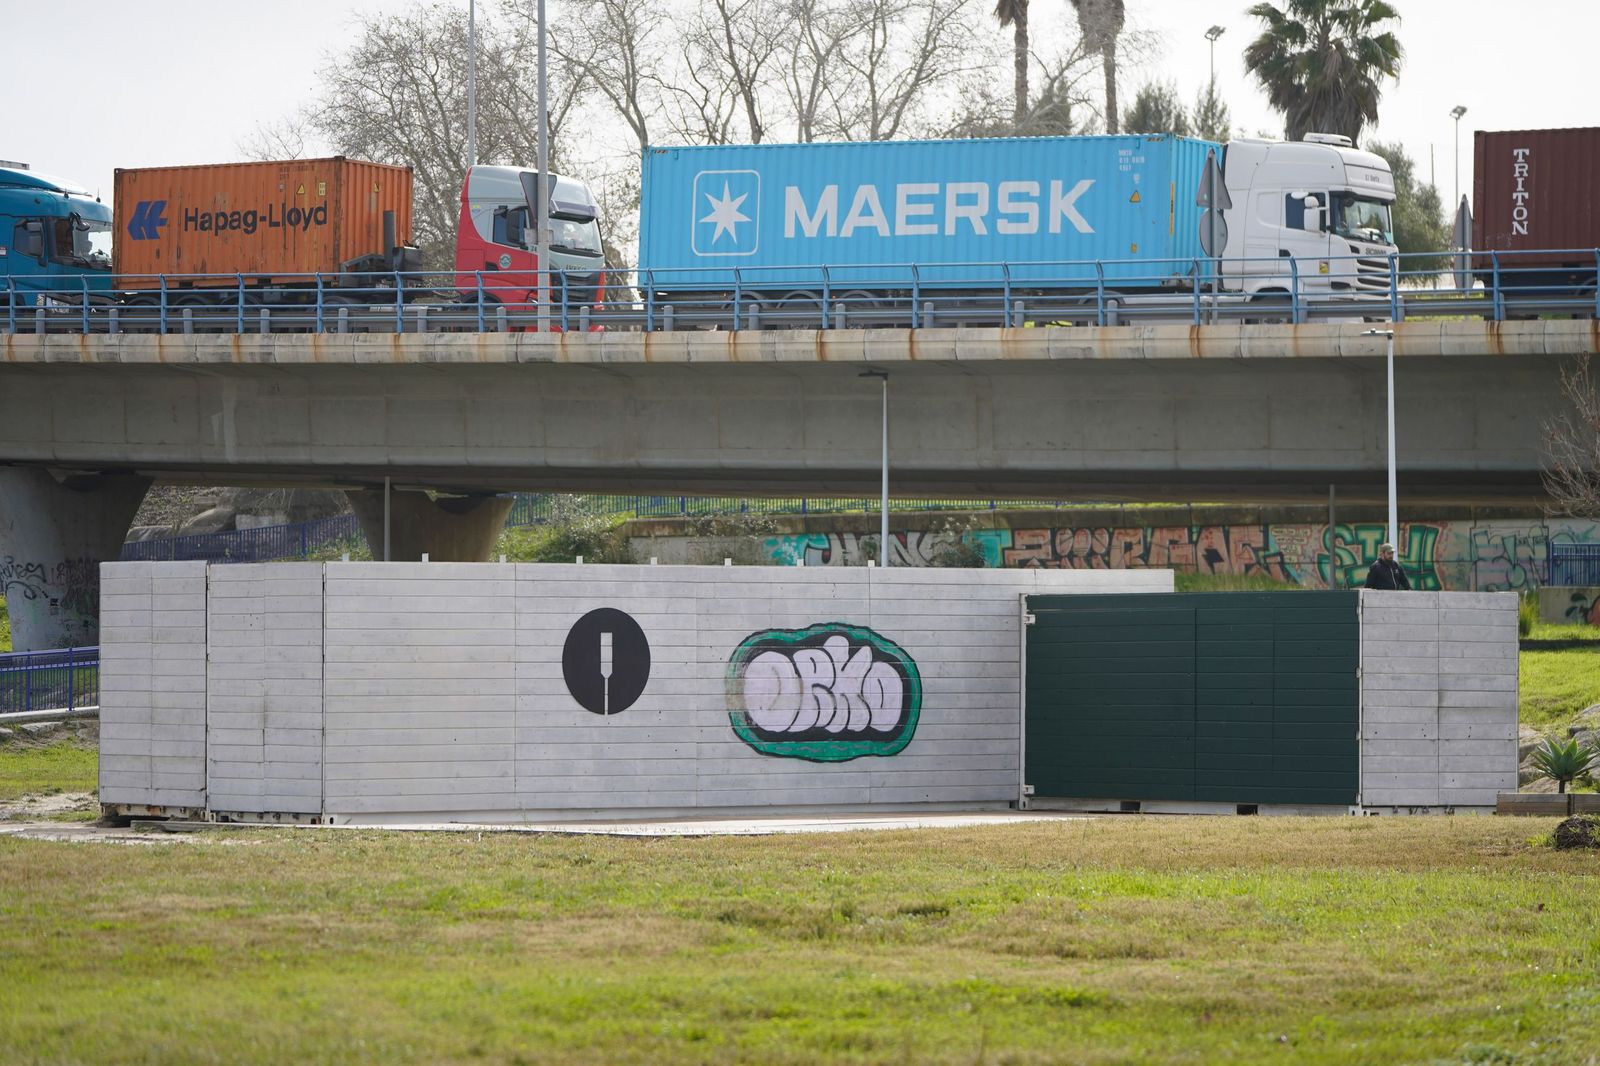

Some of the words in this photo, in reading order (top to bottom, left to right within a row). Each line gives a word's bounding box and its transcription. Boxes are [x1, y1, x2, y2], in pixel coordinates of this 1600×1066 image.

[184, 200, 328, 236] Hapag-Lloyd
[784, 179, 1096, 238] MAERSK
[1511, 148, 1530, 235] TRITON
